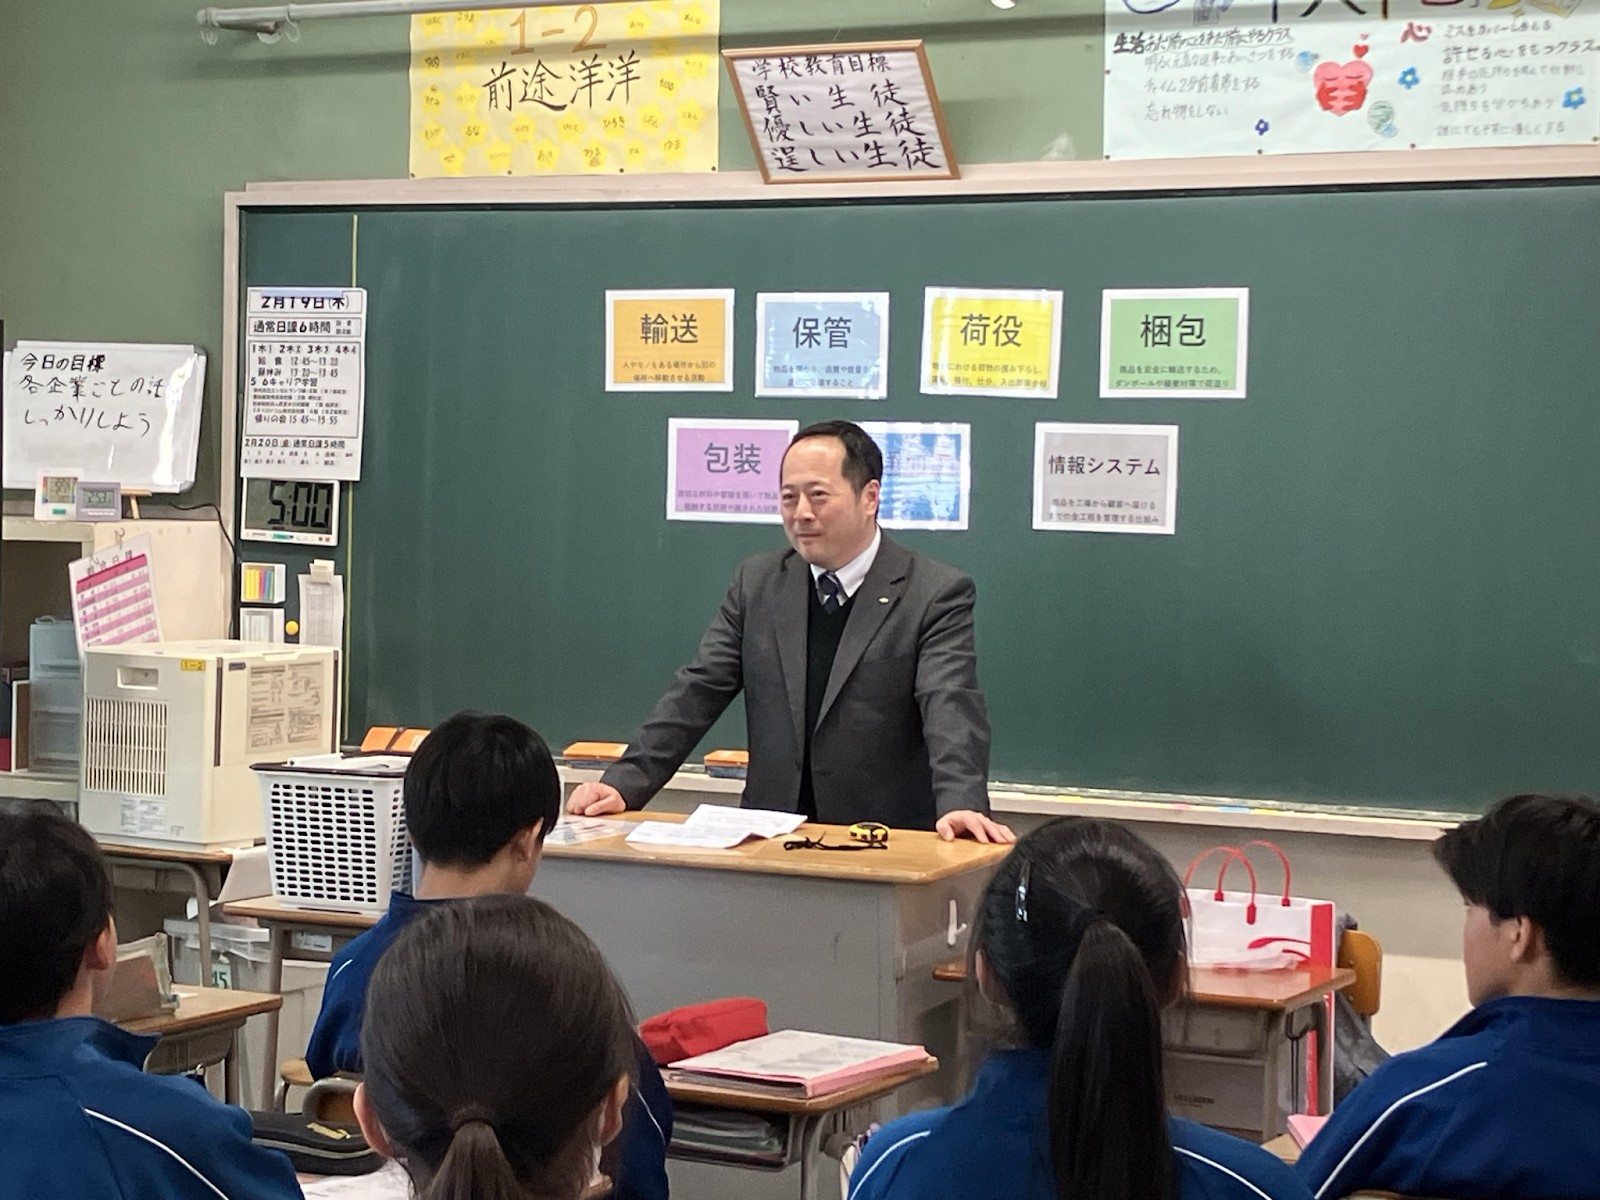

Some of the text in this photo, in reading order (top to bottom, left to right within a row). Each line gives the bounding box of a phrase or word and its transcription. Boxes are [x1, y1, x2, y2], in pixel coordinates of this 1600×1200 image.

[1113, 31, 1146, 54] 生活
[1400, 22, 1433, 44] 心
[481, 49, 641, 112] 前途洋洋
[752, 52, 892, 81] 学校教育目標
[755, 78, 909, 115] 賢い生徒
[763, 106, 926, 143] 優しい生徒
[771, 138, 942, 172] 逞しい生徒
[253, 320, 332, 334] 通常日課6時間
[640, 313, 698, 345] 輸送
[792, 316, 853, 349] 保管
[960, 313, 1023, 348] 荷役
[1140, 313, 1207, 348] 梱包
[20, 352, 106, 373] 今日の目標
[24, 404, 151, 438] しっかりしよう
[703, 442, 762, 475] 包装
[1048, 454, 1160, 476] 情報システム
[267, 480, 333, 528] 5:00
